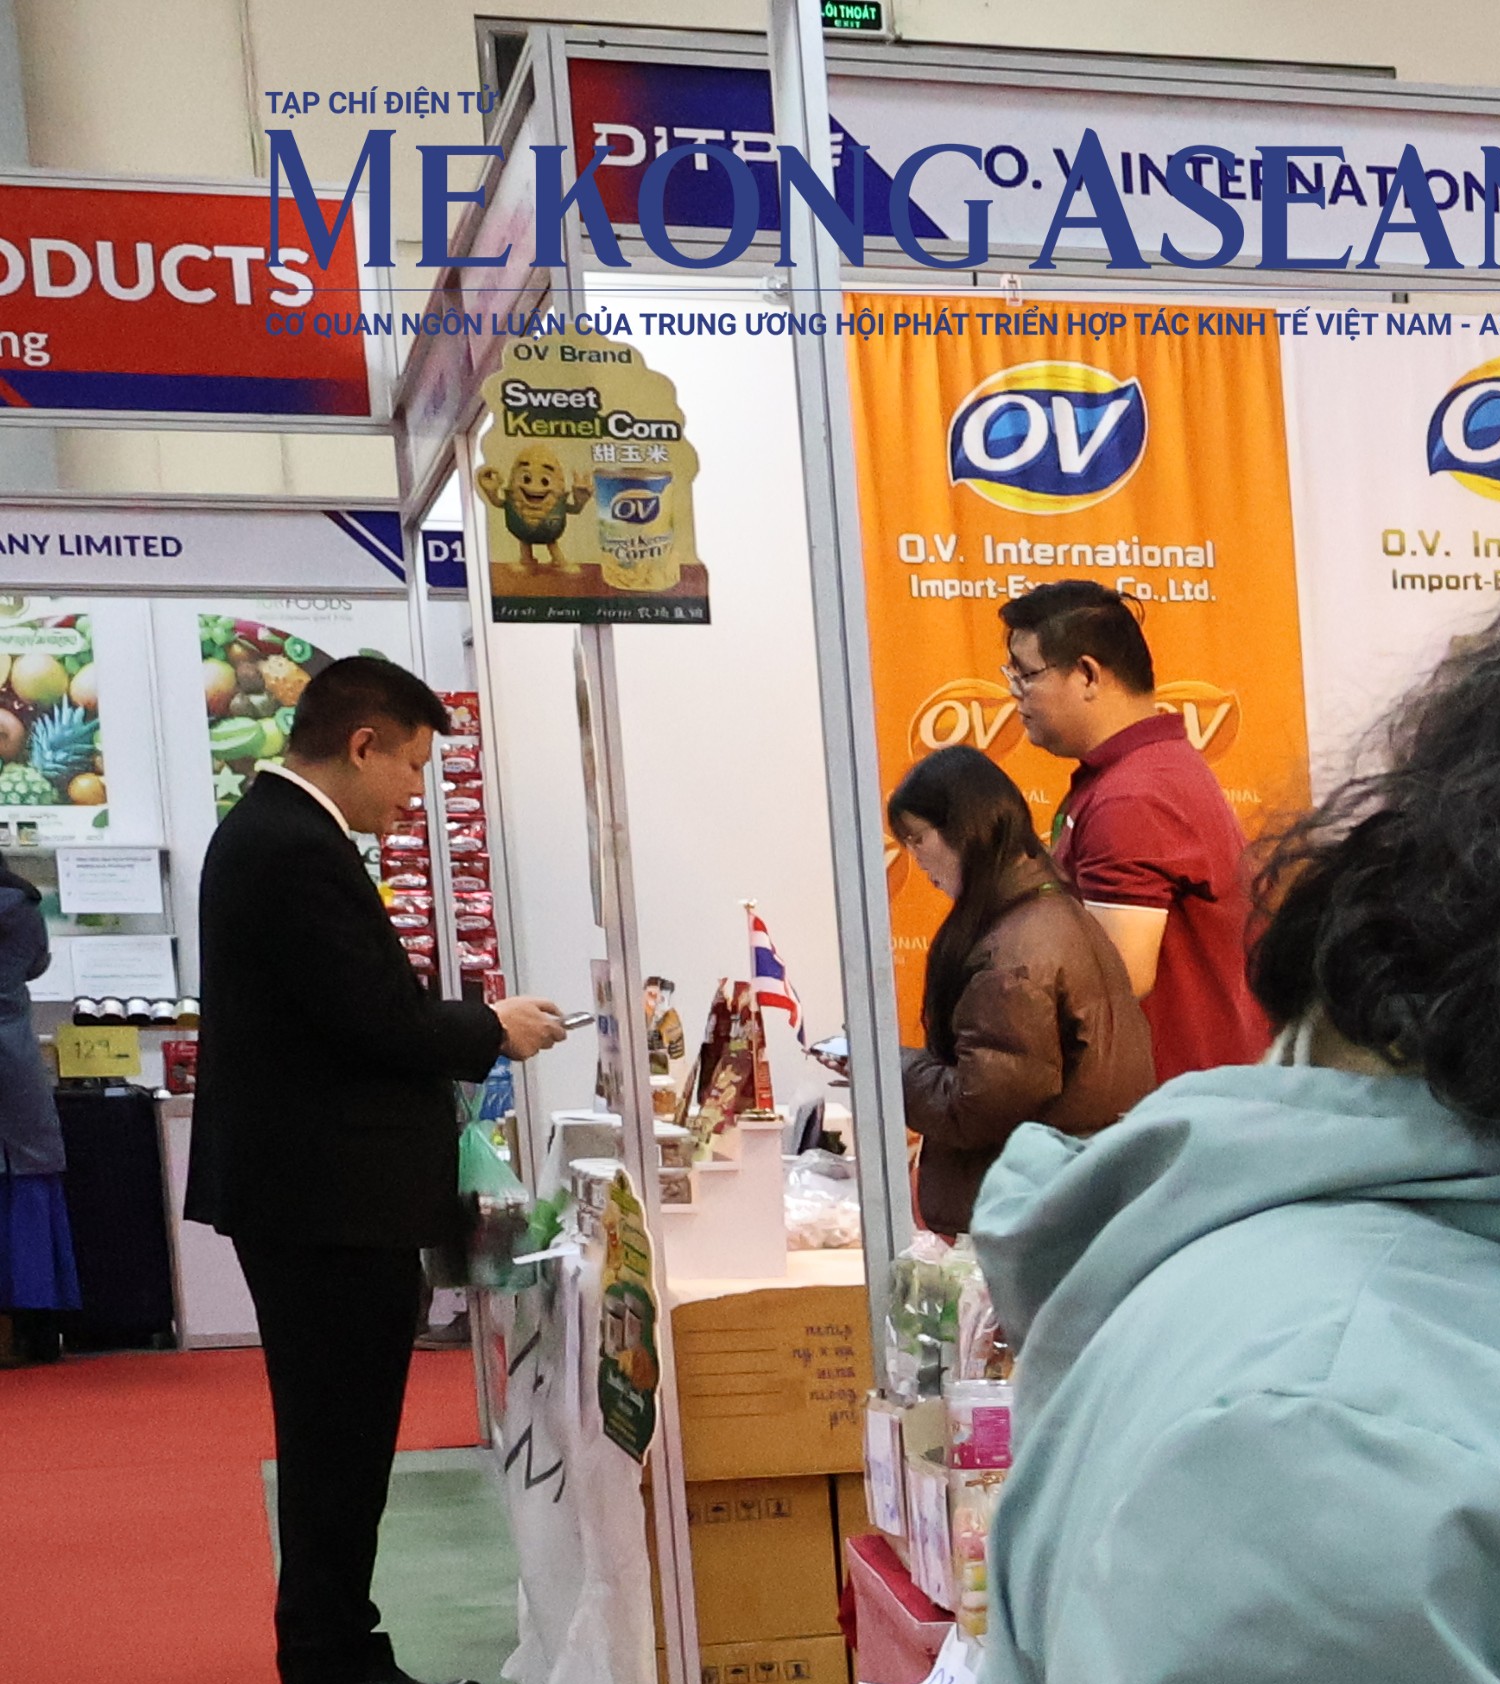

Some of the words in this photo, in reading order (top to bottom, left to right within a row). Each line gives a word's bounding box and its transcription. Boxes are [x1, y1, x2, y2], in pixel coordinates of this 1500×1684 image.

[513, 344, 550, 362] OV
[560, 345, 633, 365] Brand
[503, 381, 600, 409] Sweet
[504, 411, 602, 438] Kernel
[606, 411, 680, 440] Corn
[960, 390, 1136, 474] OV
[591, 444, 670, 464] 甜玉米
[612, 498, 659, 522] OV
[59, 533, 183, 558] LIMITED
[898, 533, 966, 564] O.V.
[983, 535, 1216, 569] International
[1381, 529, 1452, 559] O.V.
